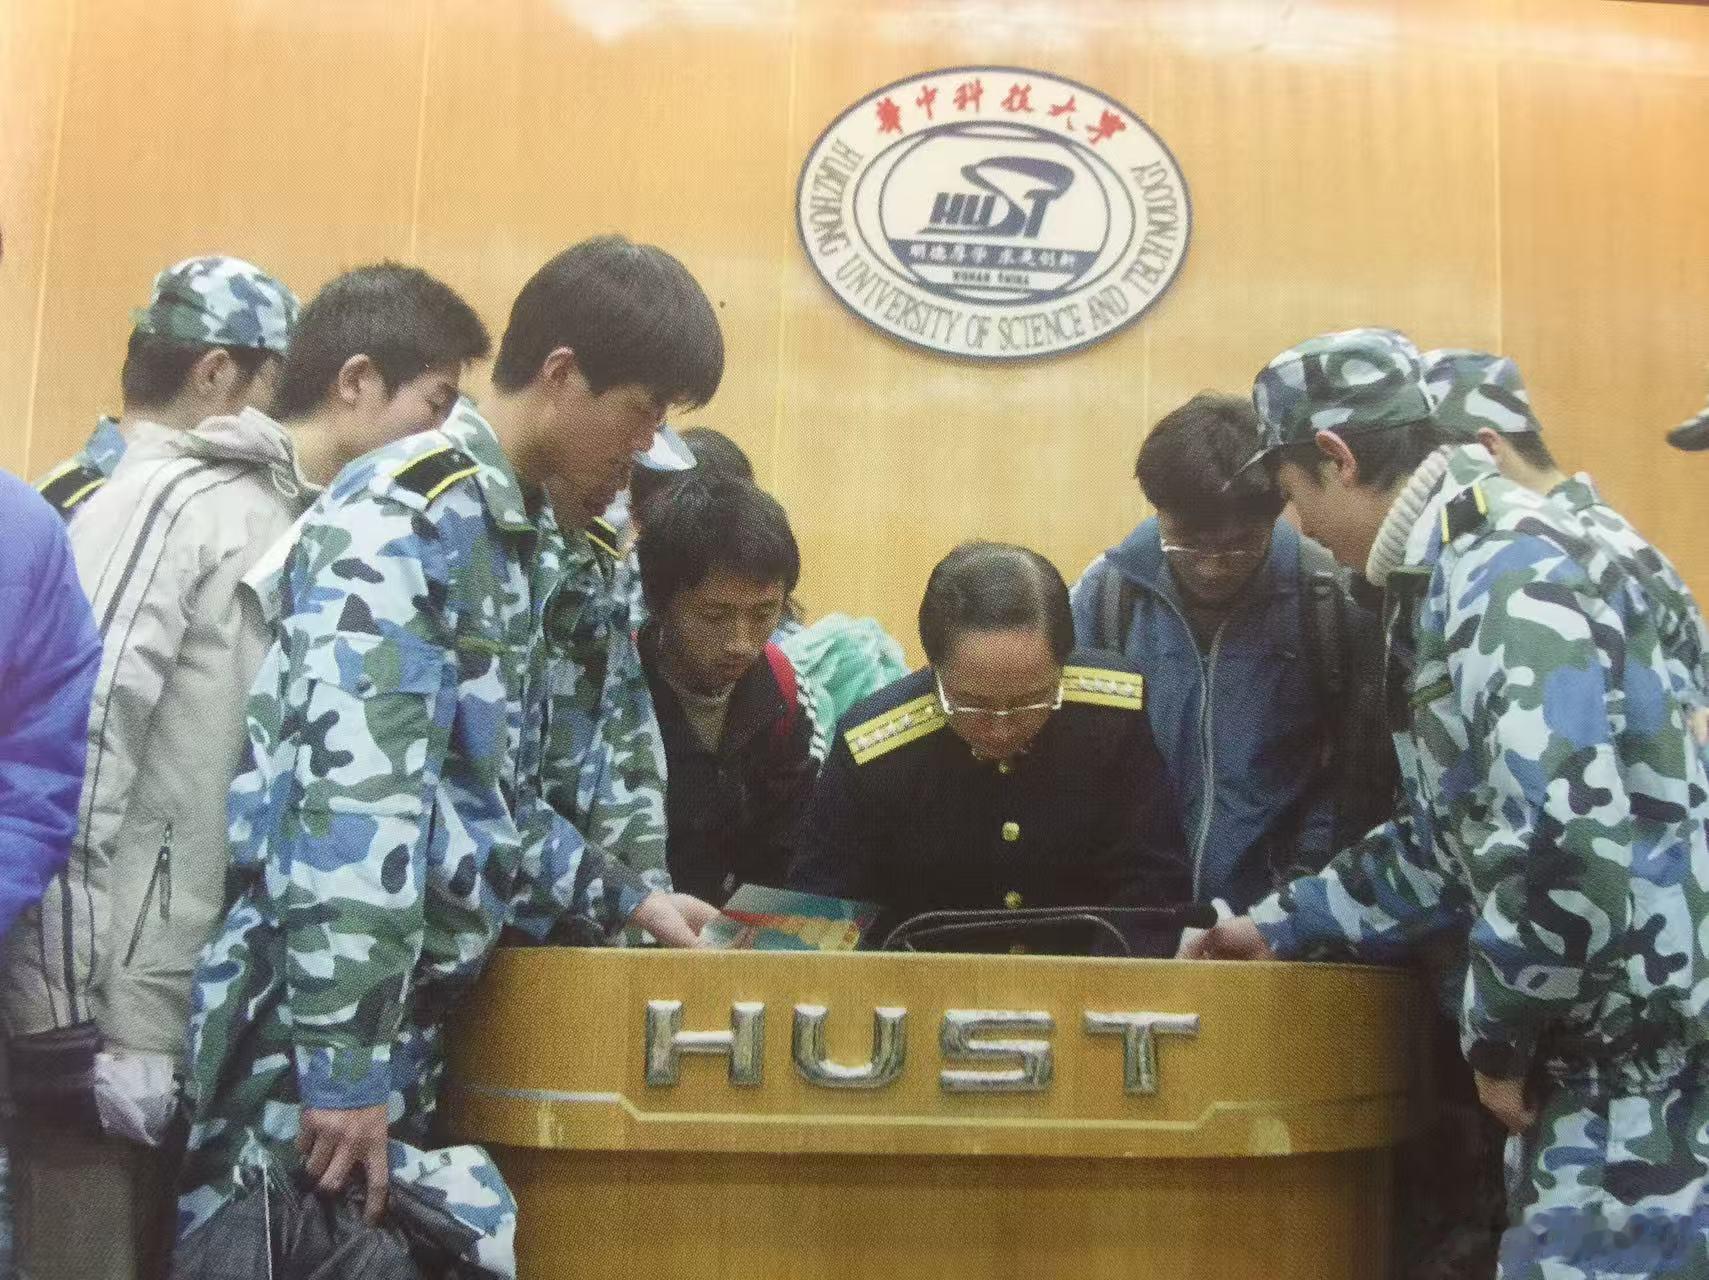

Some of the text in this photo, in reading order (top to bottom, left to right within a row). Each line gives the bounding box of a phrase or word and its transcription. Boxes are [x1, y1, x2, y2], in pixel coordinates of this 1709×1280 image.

[809, 138, 1179, 351] HUAZHONG UNIVERSITY OF SCIENCE AND TECHNOLOGY
[645, 999, 1200, 1094] HUST
